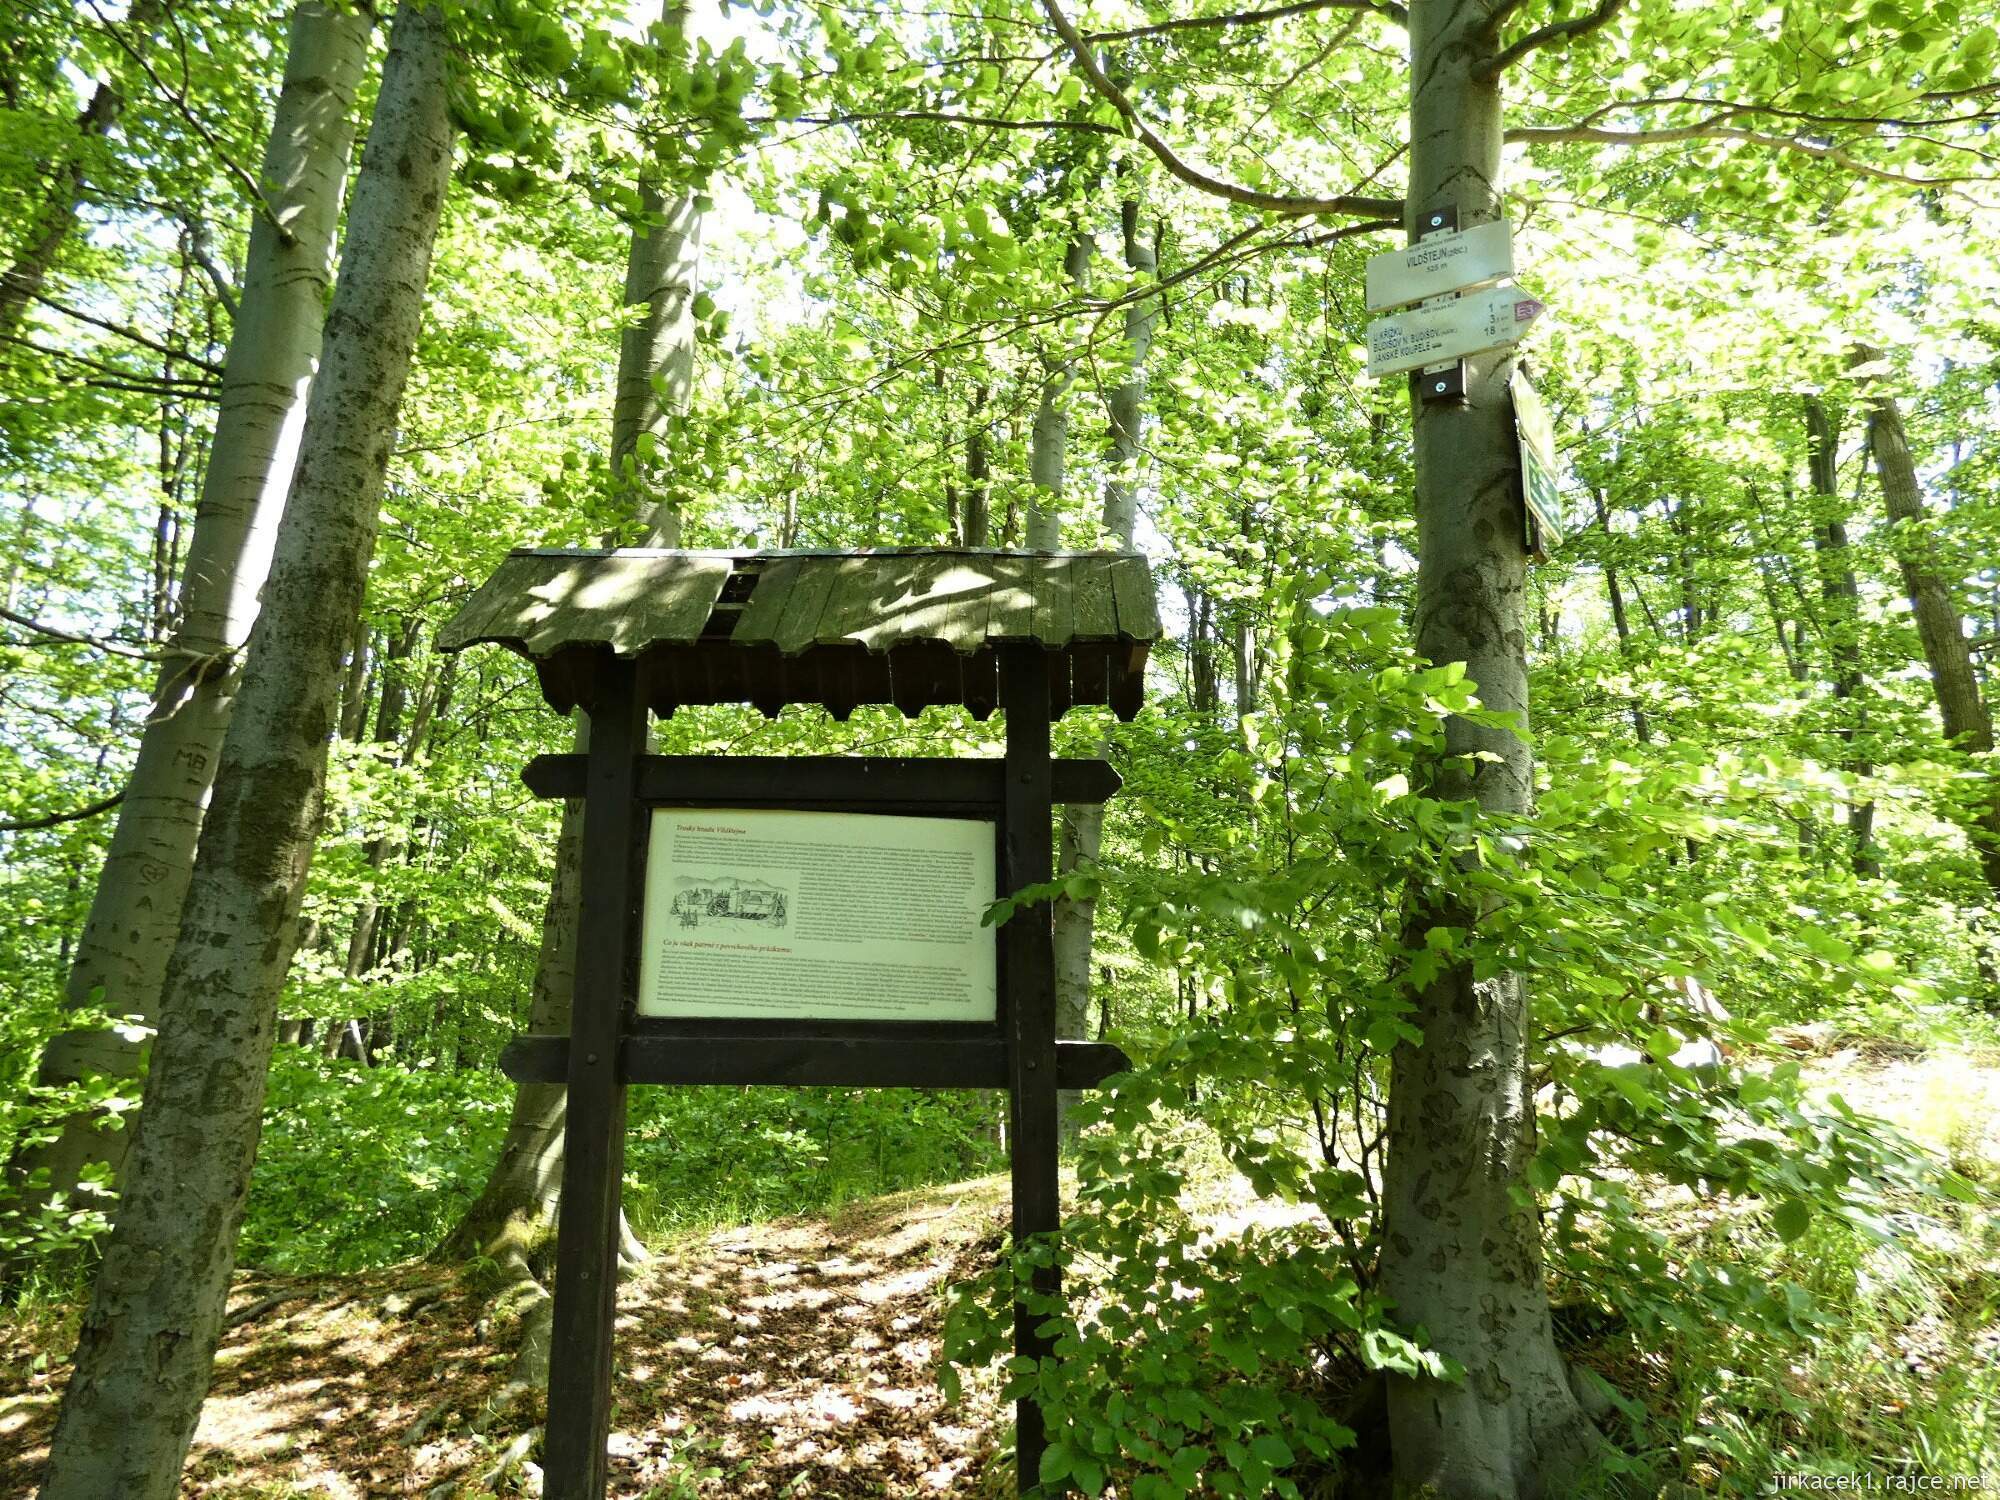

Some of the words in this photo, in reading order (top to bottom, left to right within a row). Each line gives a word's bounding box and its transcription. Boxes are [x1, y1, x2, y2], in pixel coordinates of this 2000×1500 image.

[1407, 247, 1447, 268] VILDŠTEJN
[1484, 326, 1496, 336] 18
[1399, 342, 1431, 357] KOUPELE
